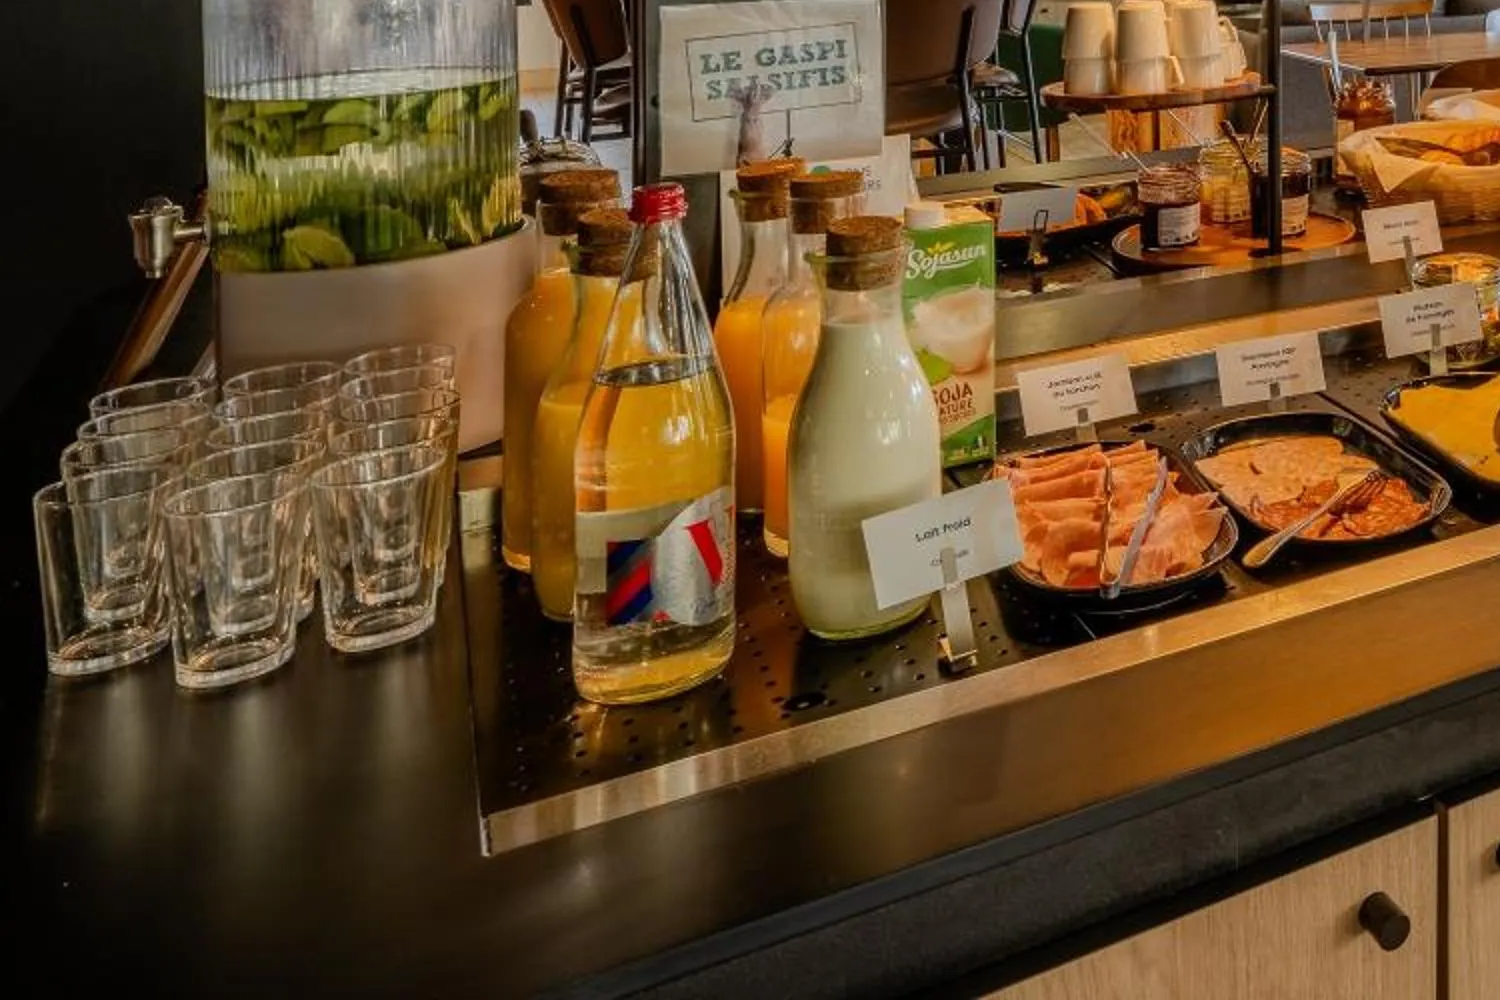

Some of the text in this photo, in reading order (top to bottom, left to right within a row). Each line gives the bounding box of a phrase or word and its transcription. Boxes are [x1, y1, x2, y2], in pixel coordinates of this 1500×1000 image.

[700, 39, 848, 75] LE GASPI
[905, 244, 987, 279] Sojasun
